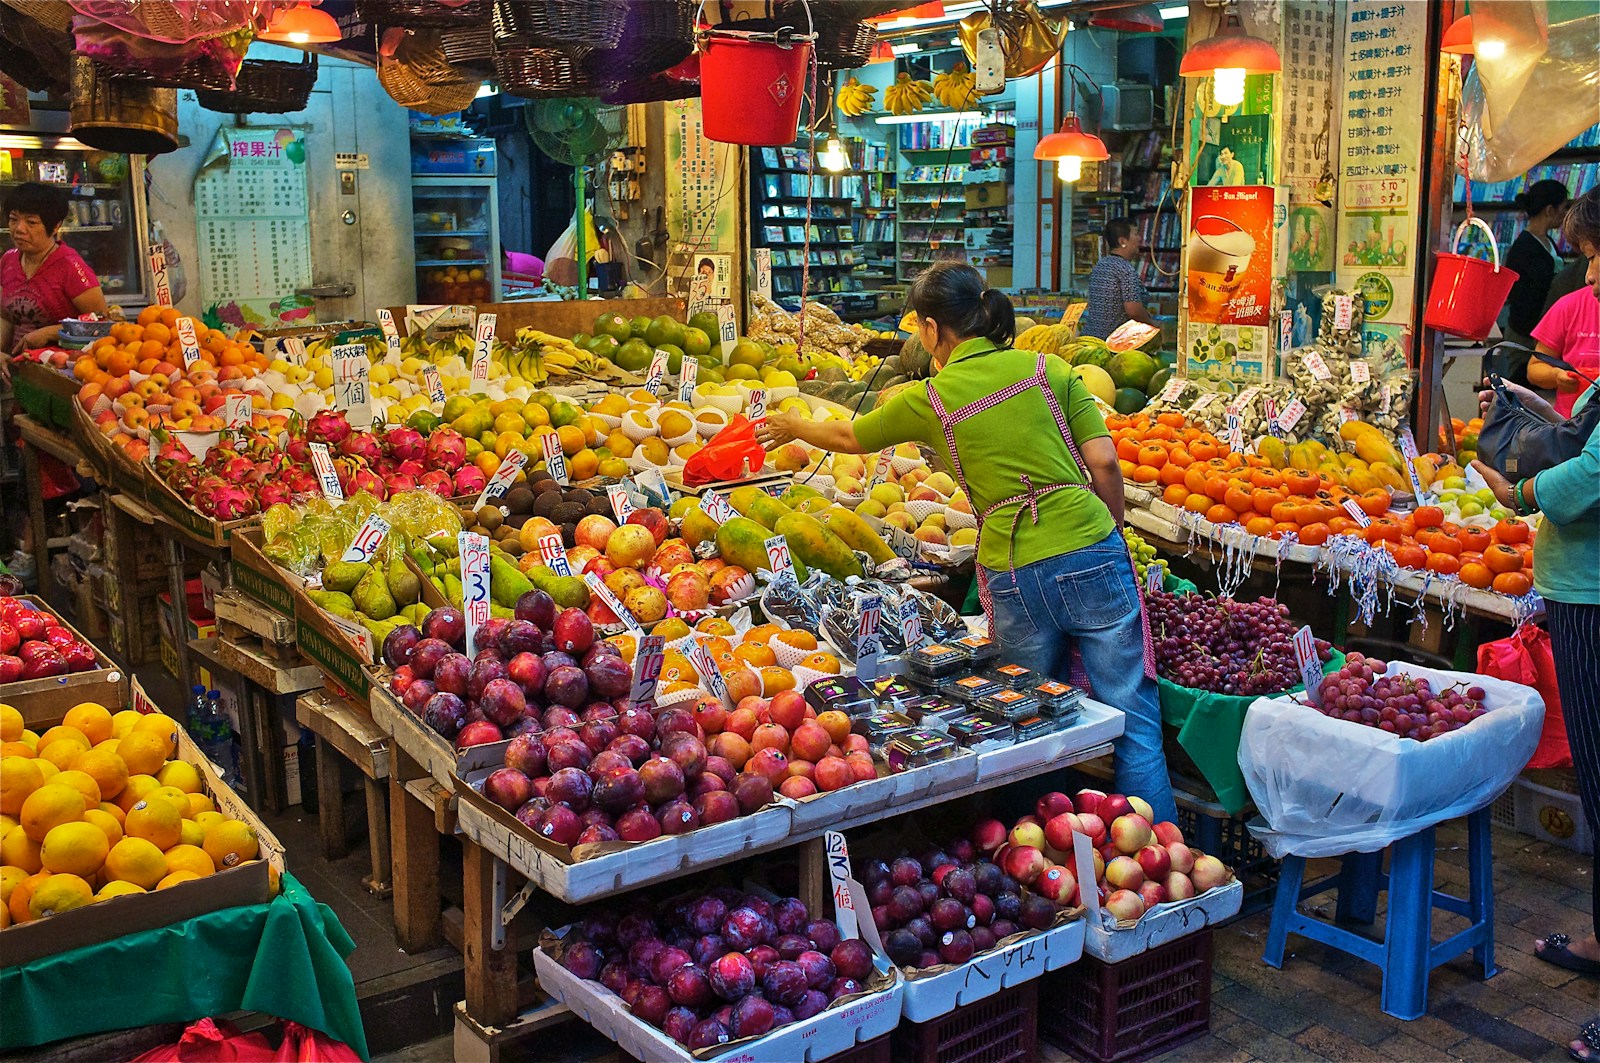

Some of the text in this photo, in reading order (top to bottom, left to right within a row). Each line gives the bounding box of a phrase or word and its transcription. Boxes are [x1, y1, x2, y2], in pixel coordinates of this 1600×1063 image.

[155, 271, 167, 288] 2
[181, 331, 196, 347] 3
[720, 322, 735, 342] 個
[475, 341, 488, 362] 3
[474, 361, 487, 380] 個
[342, 382, 365, 406] 個
[231, 395, 250, 417] 7元
[751, 403, 765, 418] 2
[497, 465, 516, 483] 4
[548, 455, 567, 481] 個
[611, 491, 633, 516] 12元
[540, 536, 564, 560] 10元
[769, 546, 792, 573] 20元
[467, 549, 490, 573] 20元
[472, 573, 487, 602] 3
[826, 833, 848, 856] 12元
[831, 856, 850, 881] 3
